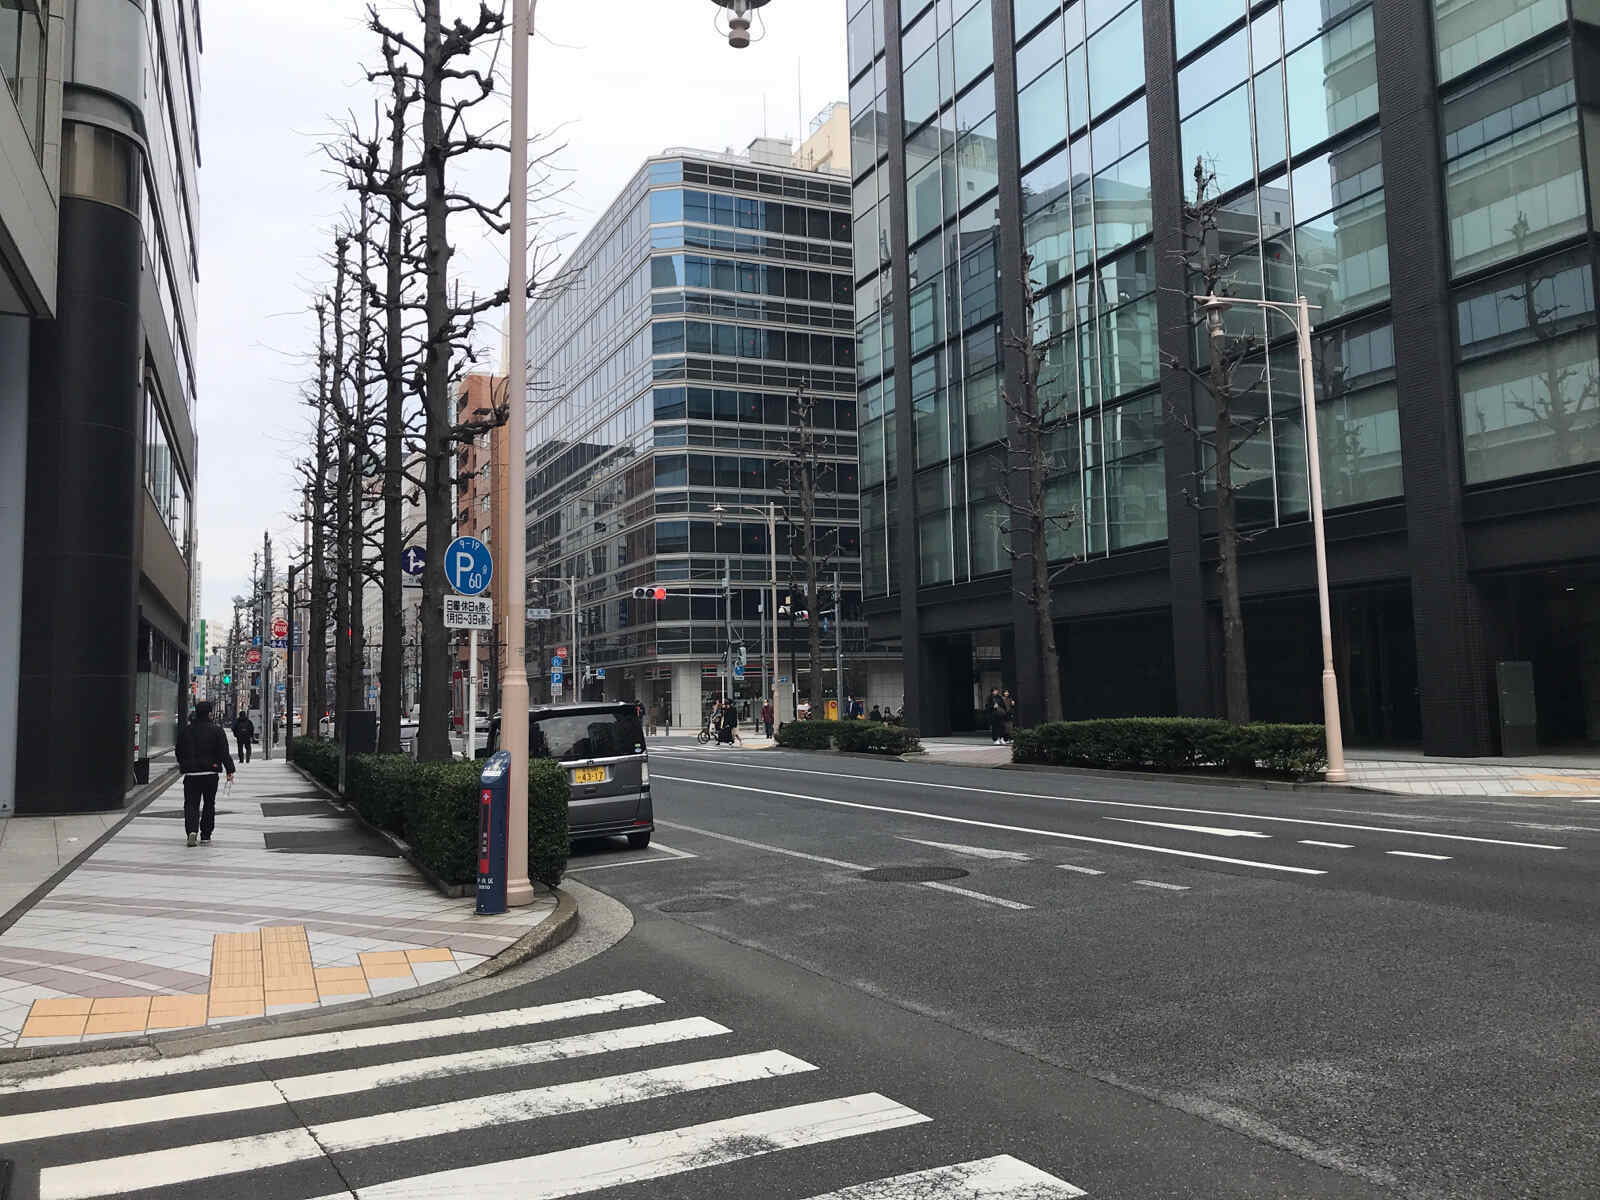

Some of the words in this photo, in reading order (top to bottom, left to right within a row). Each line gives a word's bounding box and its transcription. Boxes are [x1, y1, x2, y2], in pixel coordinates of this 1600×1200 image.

[459, 540, 480, 551] 9-19
[456, 551, 475, 587] P
[468, 572, 482, 589] 60
[553, 673, 561, 682] P
